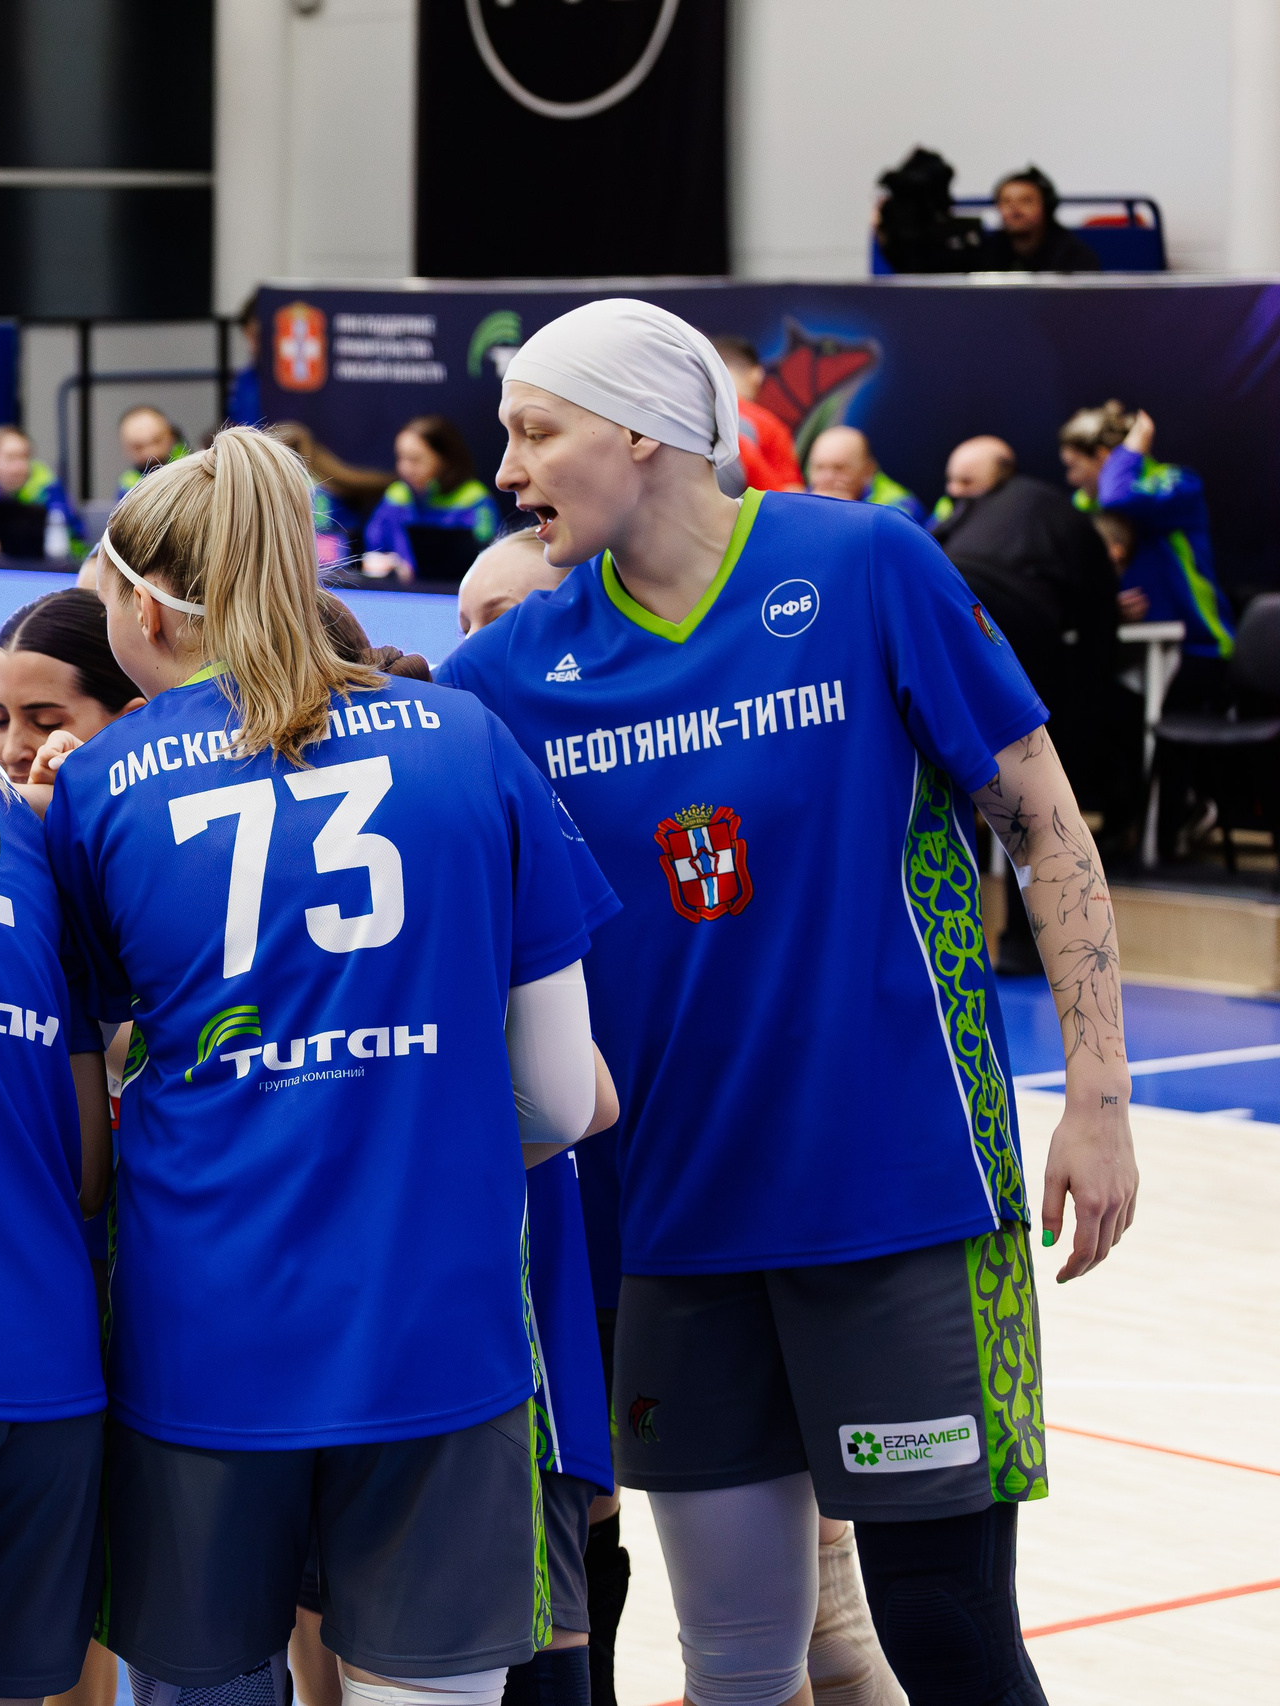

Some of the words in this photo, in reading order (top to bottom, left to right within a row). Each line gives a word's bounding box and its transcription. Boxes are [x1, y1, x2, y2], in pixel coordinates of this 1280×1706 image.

[769, 594, 812, 620] РФБ
[545, 667, 582, 682] PEAK
[308, 699, 441, 743] ЛАСТЬ
[545, 680, 846, 779] НЕФТЯНИК-ТИТАН
[168, 755, 405, 979] 73
[258, 1075, 300, 1092] группа
[302, 1065, 365, 1083] компаний
[883, 1427, 970, 1449] EZRAMED
[886, 1447, 933, 1461] CLINIC
